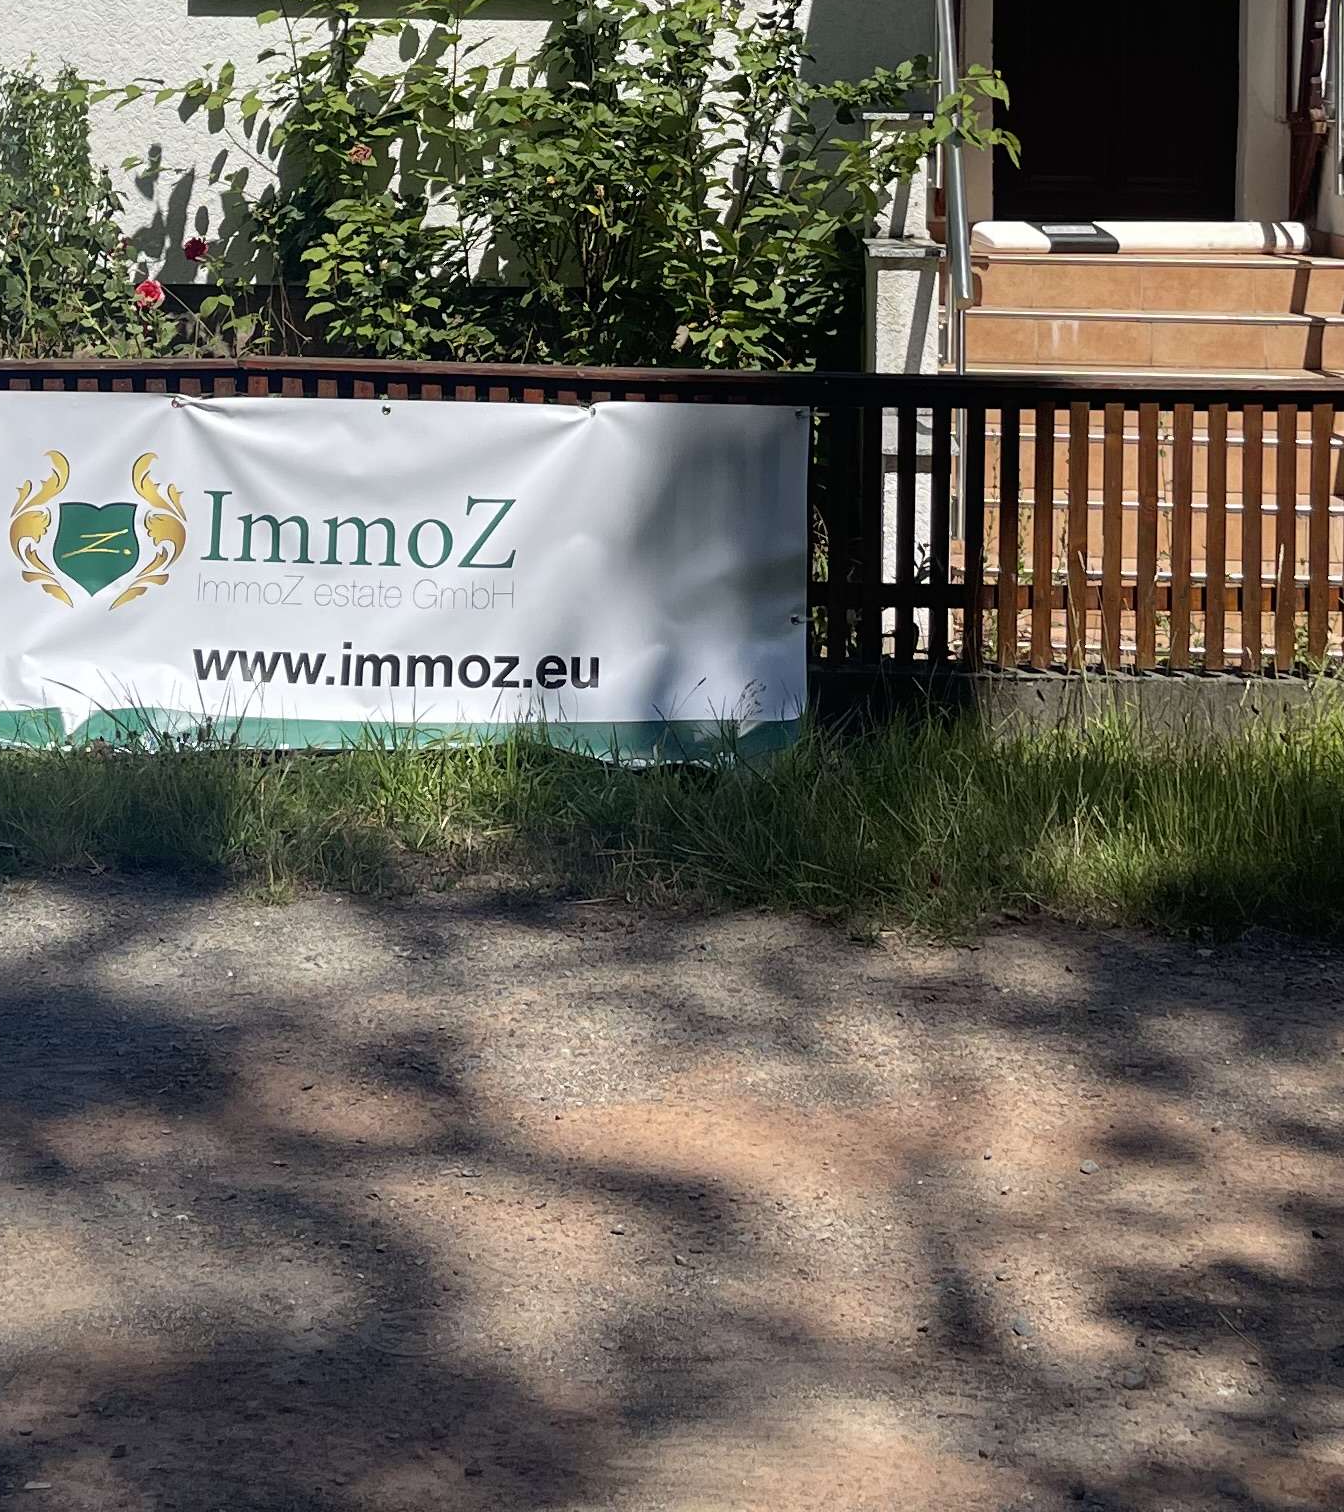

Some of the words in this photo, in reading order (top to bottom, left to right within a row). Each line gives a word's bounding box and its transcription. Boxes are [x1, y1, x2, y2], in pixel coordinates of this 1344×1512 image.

[200, 490, 517, 569] ImmoZ
[196, 572, 305, 606] ImmoZ
[313, 576, 403, 609] estate
[412, 576, 515, 610] GmbH
[192, 641, 600, 690] www.immoz.eu
